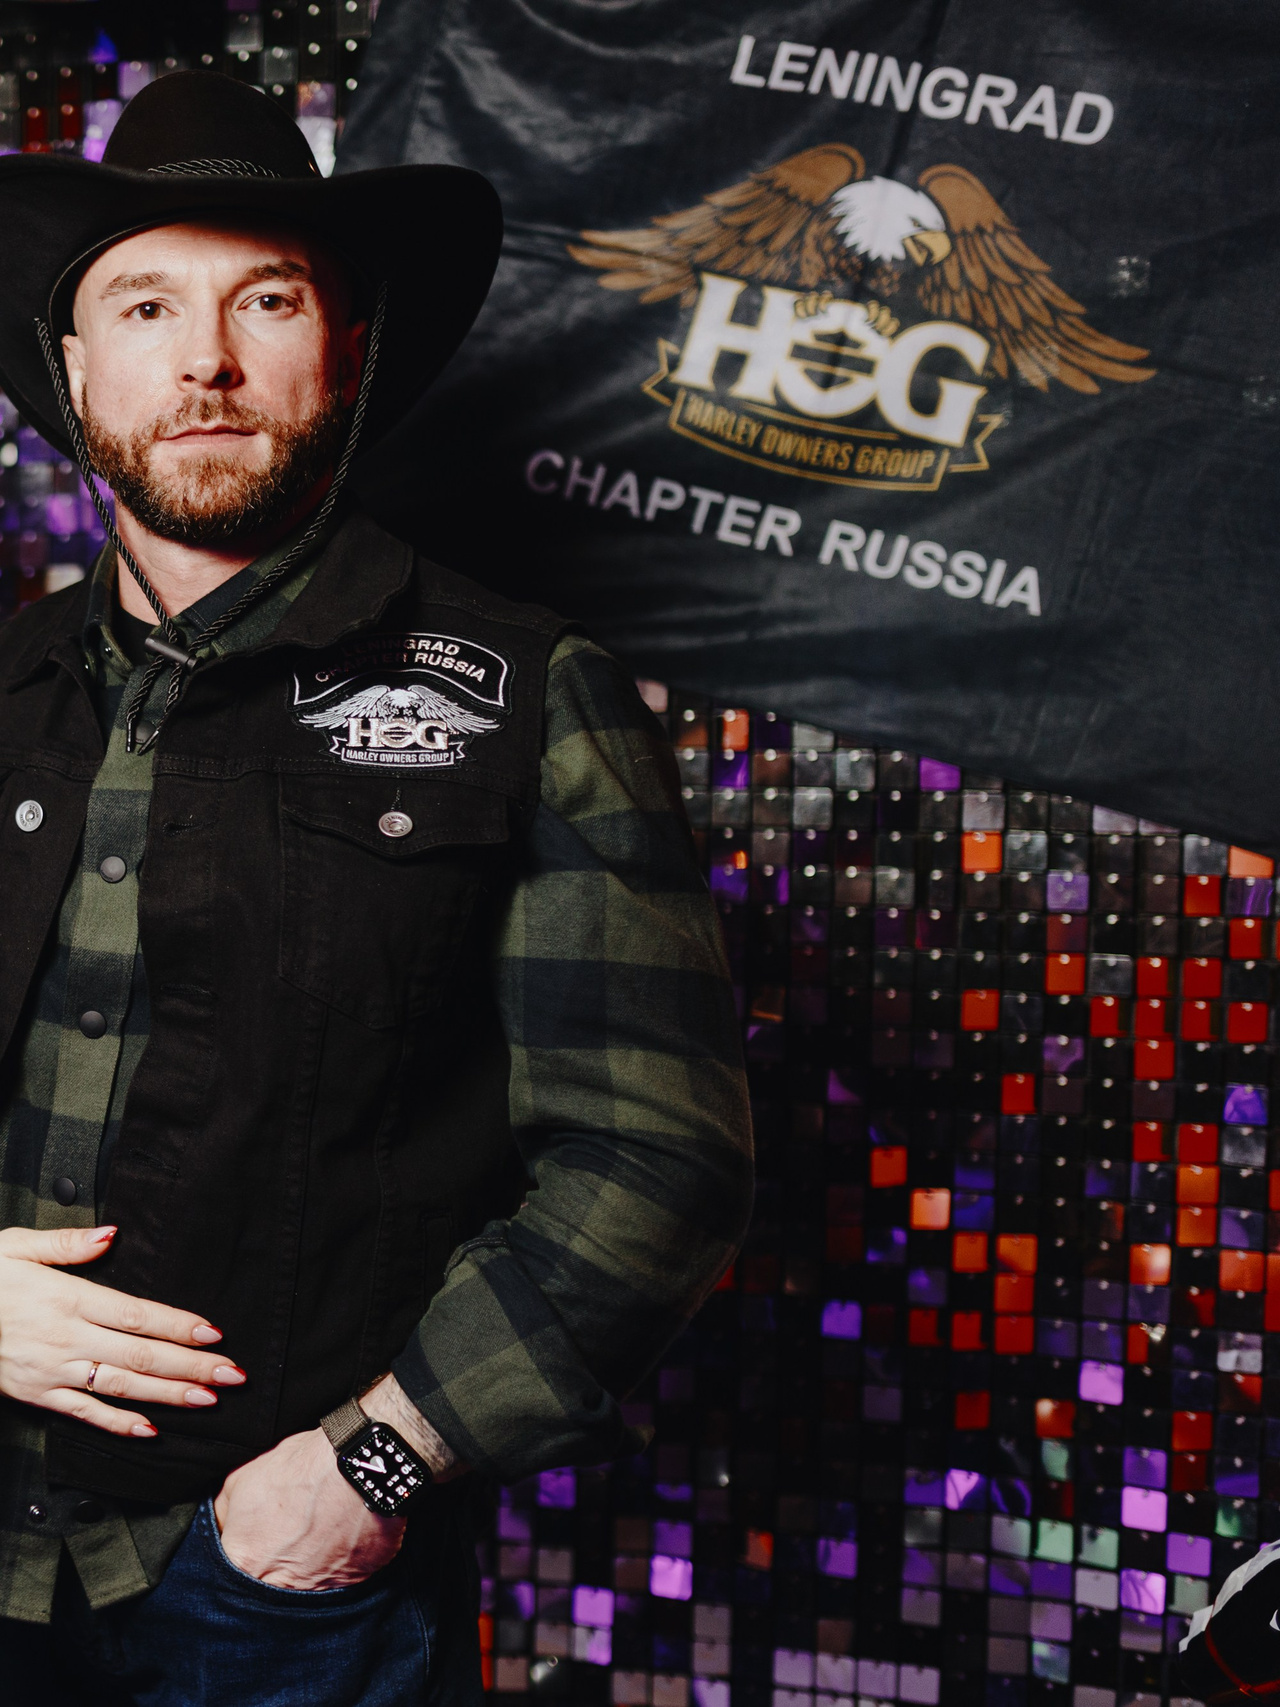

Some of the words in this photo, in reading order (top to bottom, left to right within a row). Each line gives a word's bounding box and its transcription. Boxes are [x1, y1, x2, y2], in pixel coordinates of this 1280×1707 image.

[730, 35, 1115, 146] LENINGRAD
[684, 394, 762, 448] HARLEY
[761, 427, 851, 471] OWNERS
[855, 444, 935, 478] GROUP
[525, 449, 802, 556] CHAPTER
[820, 520, 1042, 616] RUSSIA
[414, 652, 487, 682] RUSSIA
[346, 749, 378, 761] HARLEY
[380, 753, 417, 763] OWNERS
[418, 752, 449, 762] GROUP
[375, 1439, 382, 1448] 7
[362, 1448, 371, 1457] 6
[385, 1444, 394, 1453] 8
[395, 1454, 404, 1463] 9
[401, 1464, 412, 1475] 10
[357, 1470, 365, 1479] 4
[366, 1480, 374, 1489] 3
[406, 1476, 417, 1486] 11
[374, 1489, 383, 1498] 2
[396, 1485, 407, 1496] 12
[386, 1496, 394, 1504] 1
